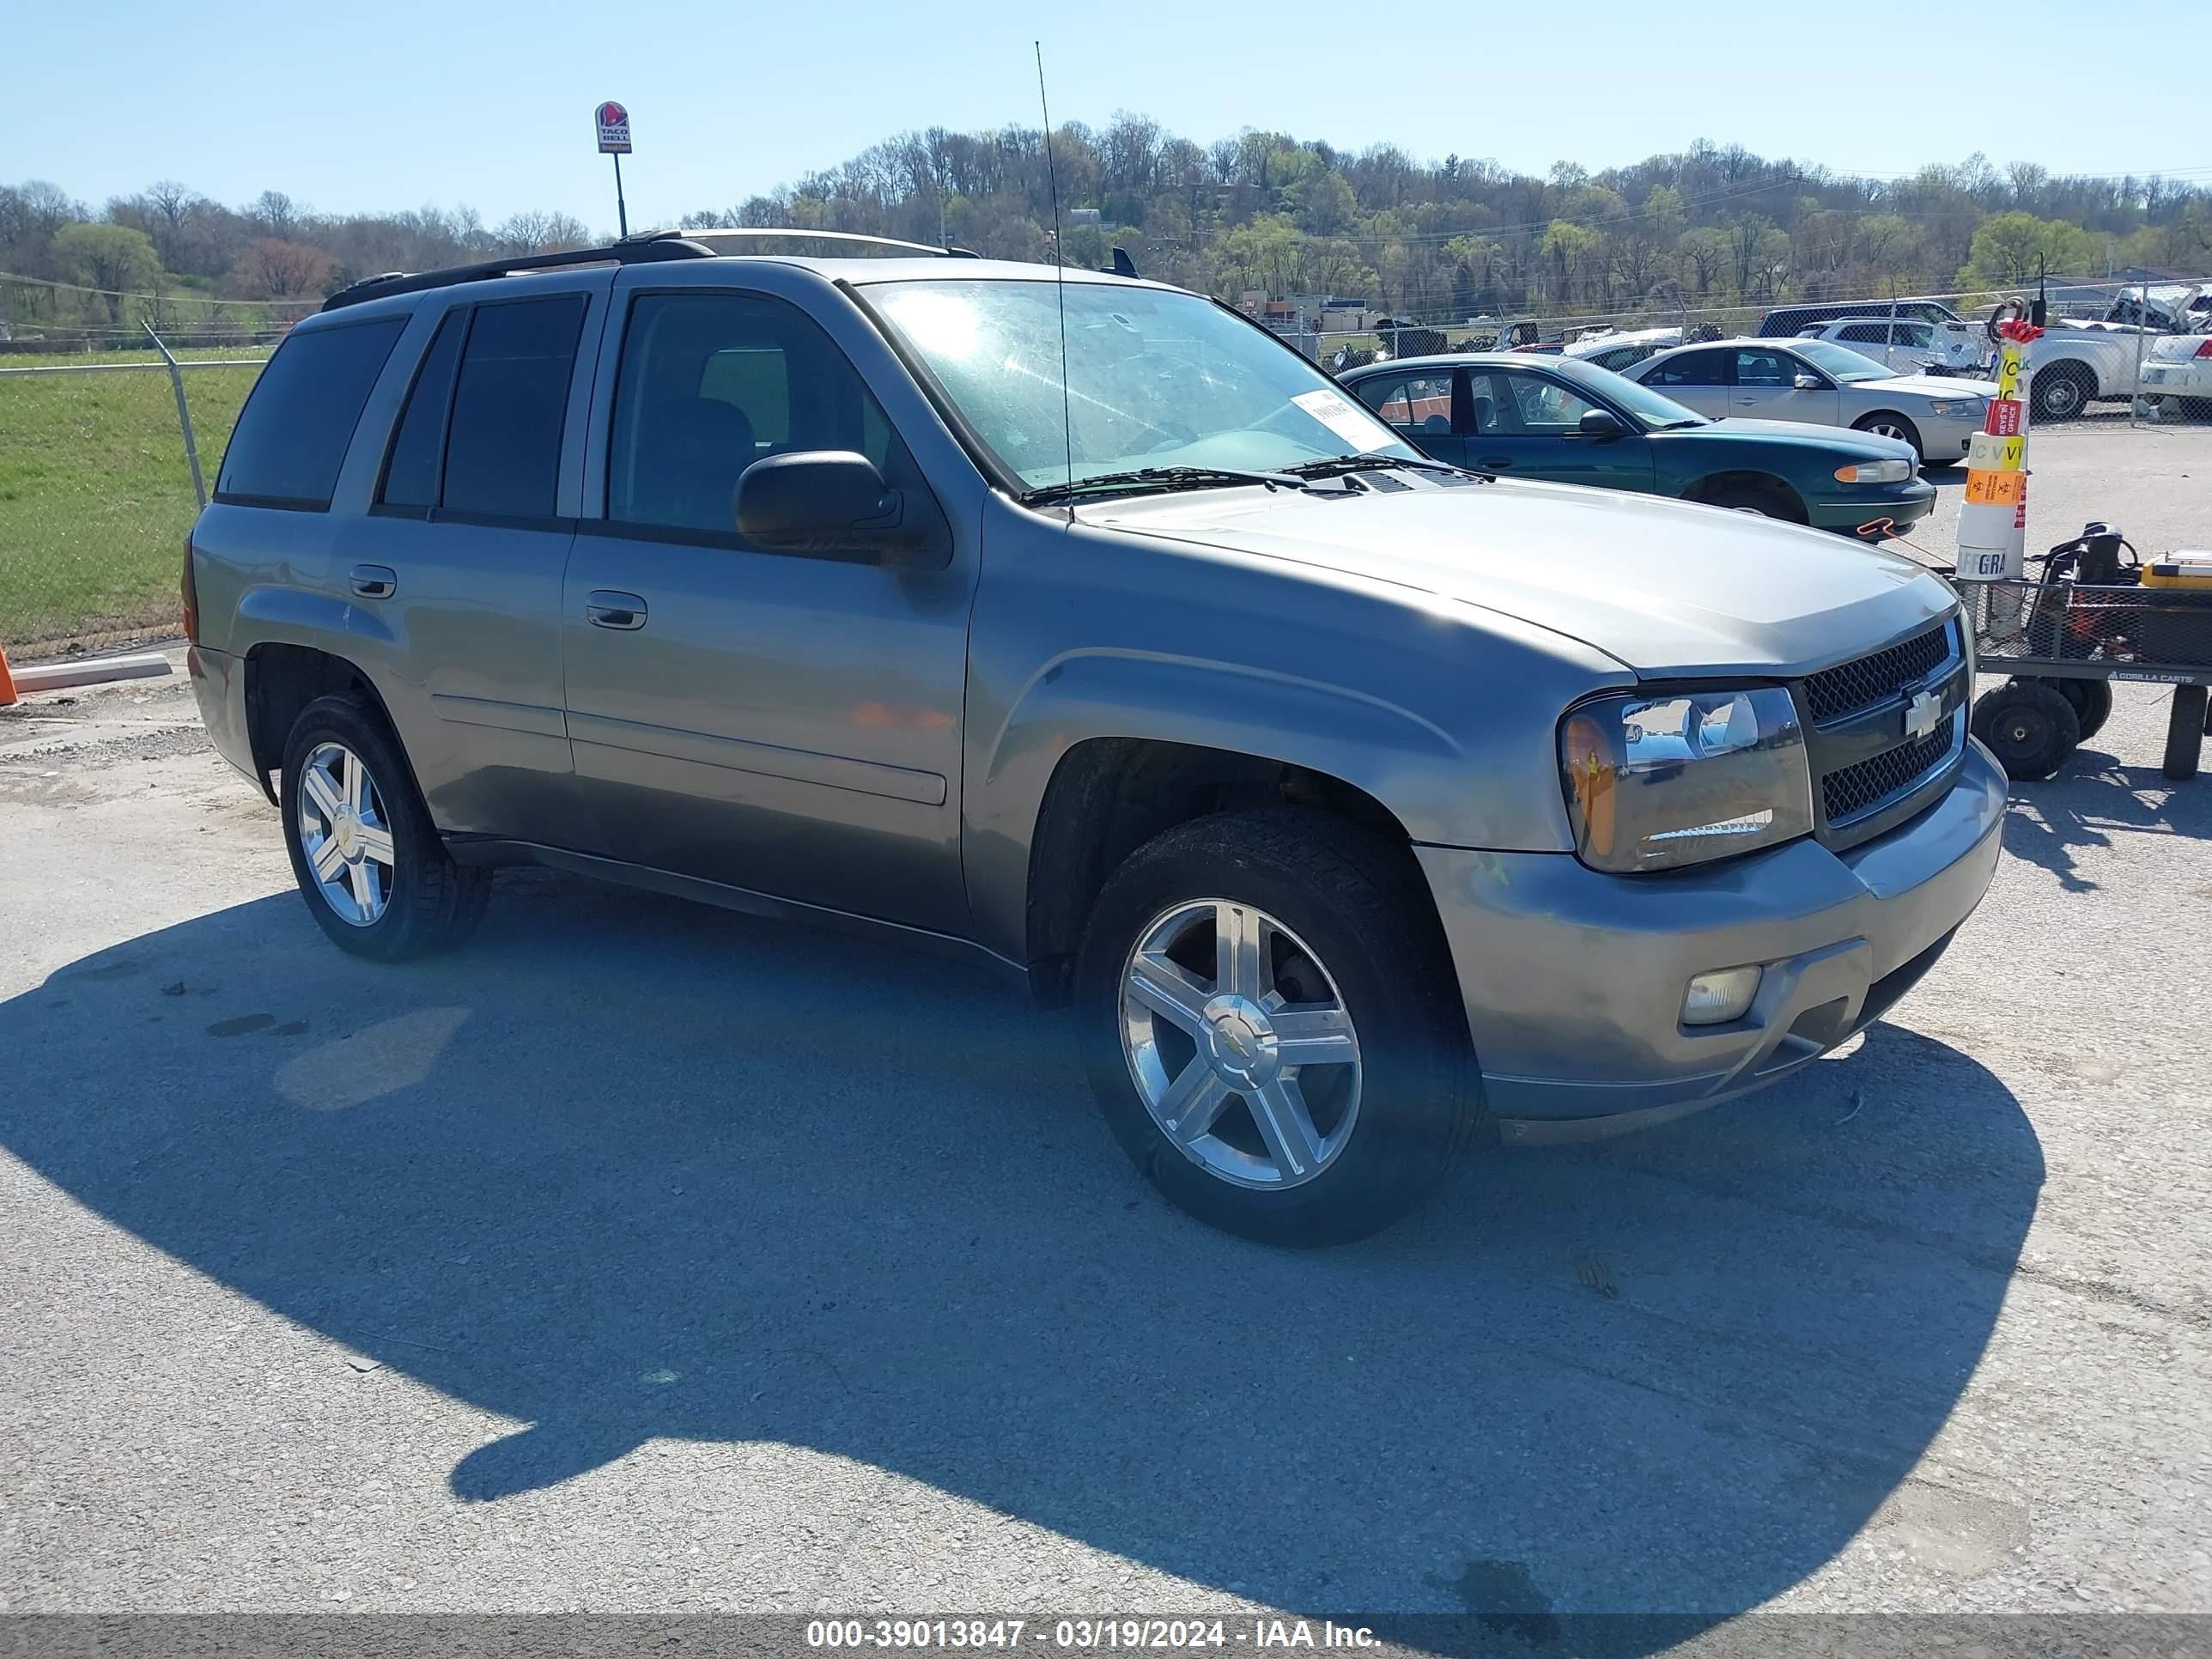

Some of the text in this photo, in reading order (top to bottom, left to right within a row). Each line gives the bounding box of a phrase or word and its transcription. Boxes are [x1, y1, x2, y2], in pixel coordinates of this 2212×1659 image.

[2008, 405, 2016, 433] OFFICE
[2118, 672, 2192, 684] GORILLA CARTS
